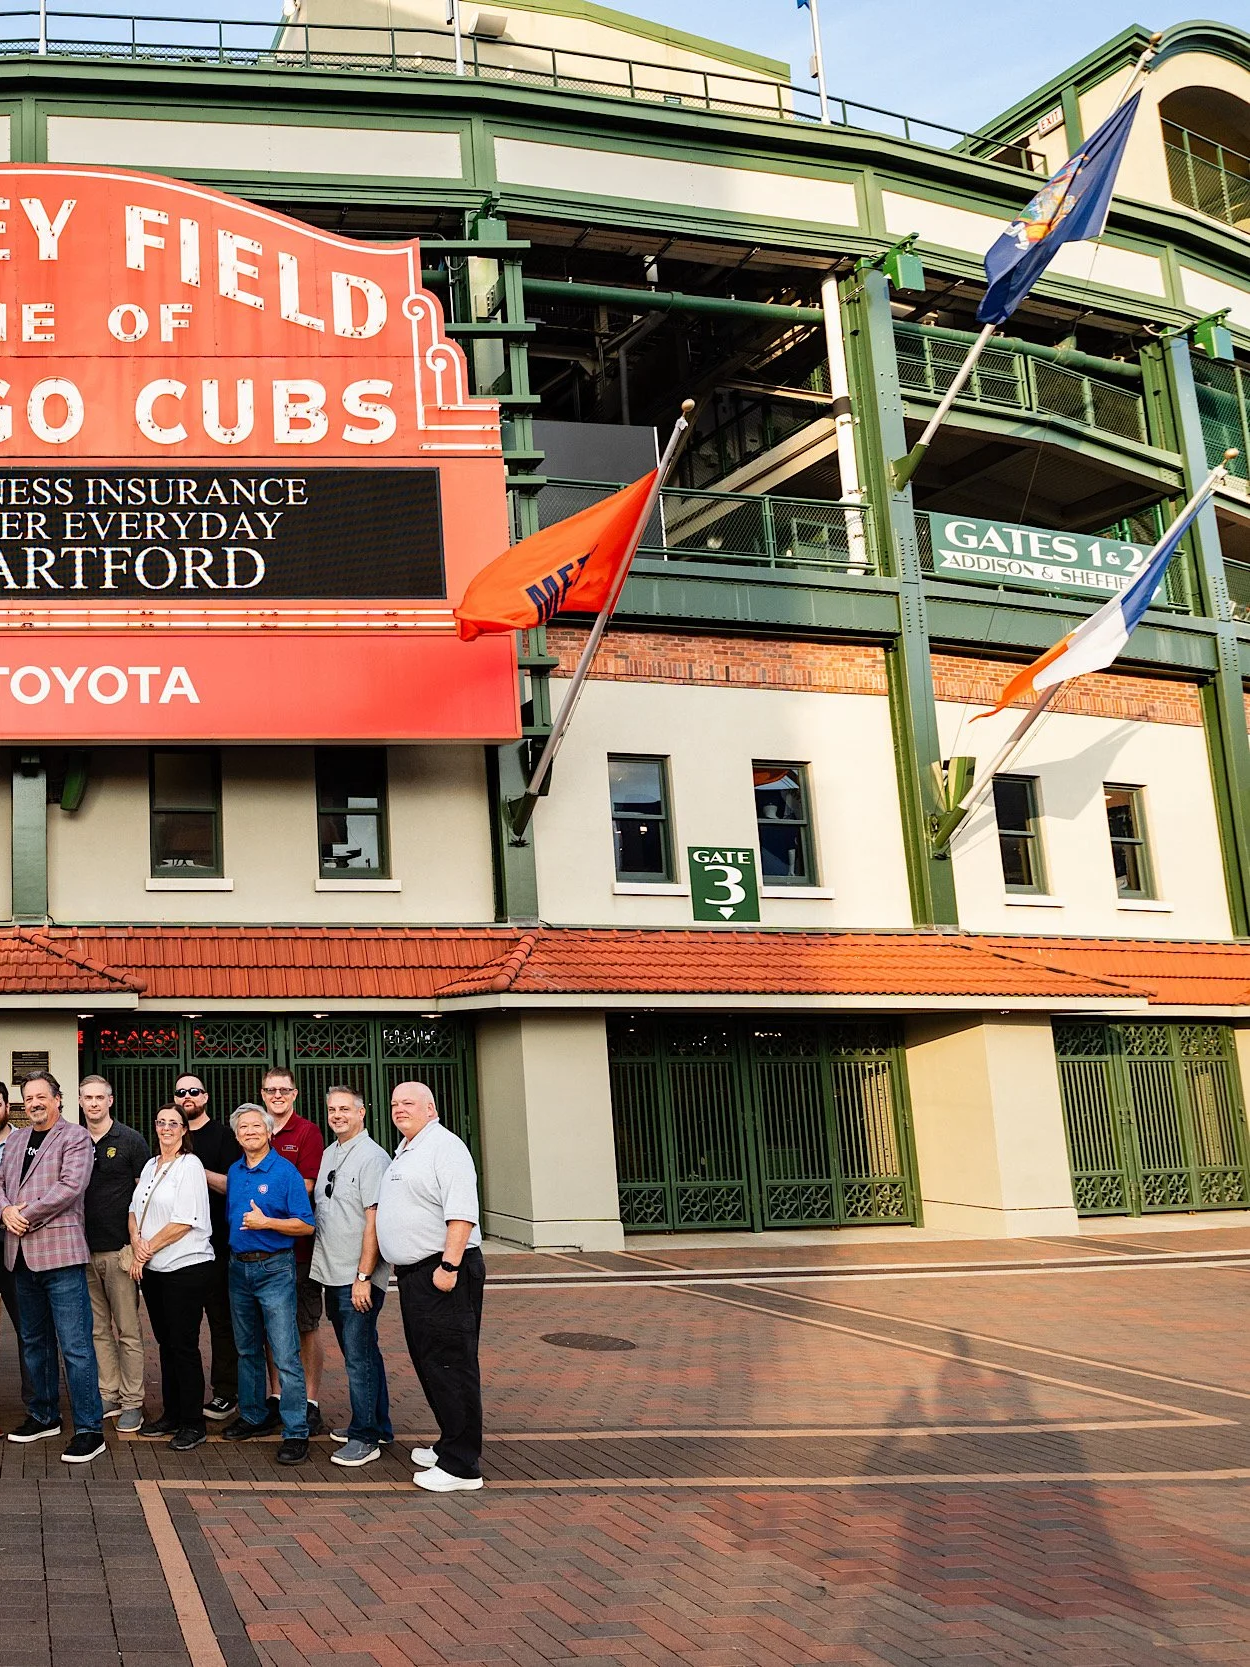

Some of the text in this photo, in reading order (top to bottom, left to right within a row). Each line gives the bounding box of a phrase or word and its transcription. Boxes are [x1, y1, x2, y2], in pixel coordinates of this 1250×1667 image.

[1041, 110, 1059, 130] EXIT
[125, 204, 388, 340] FIELD
[107, 303, 193, 342] OF
[135, 378, 397, 445] CUBS
[85, 477, 309, 506] INSURANCE
[62, 511, 285, 541] EVERYDAY
[944, 521, 1079, 563] GATES
[949, 554, 1131, 590] ADDISON & SHEFFIE
[692, 850, 751, 864] GATE
[704, 864, 746, 906] 3
